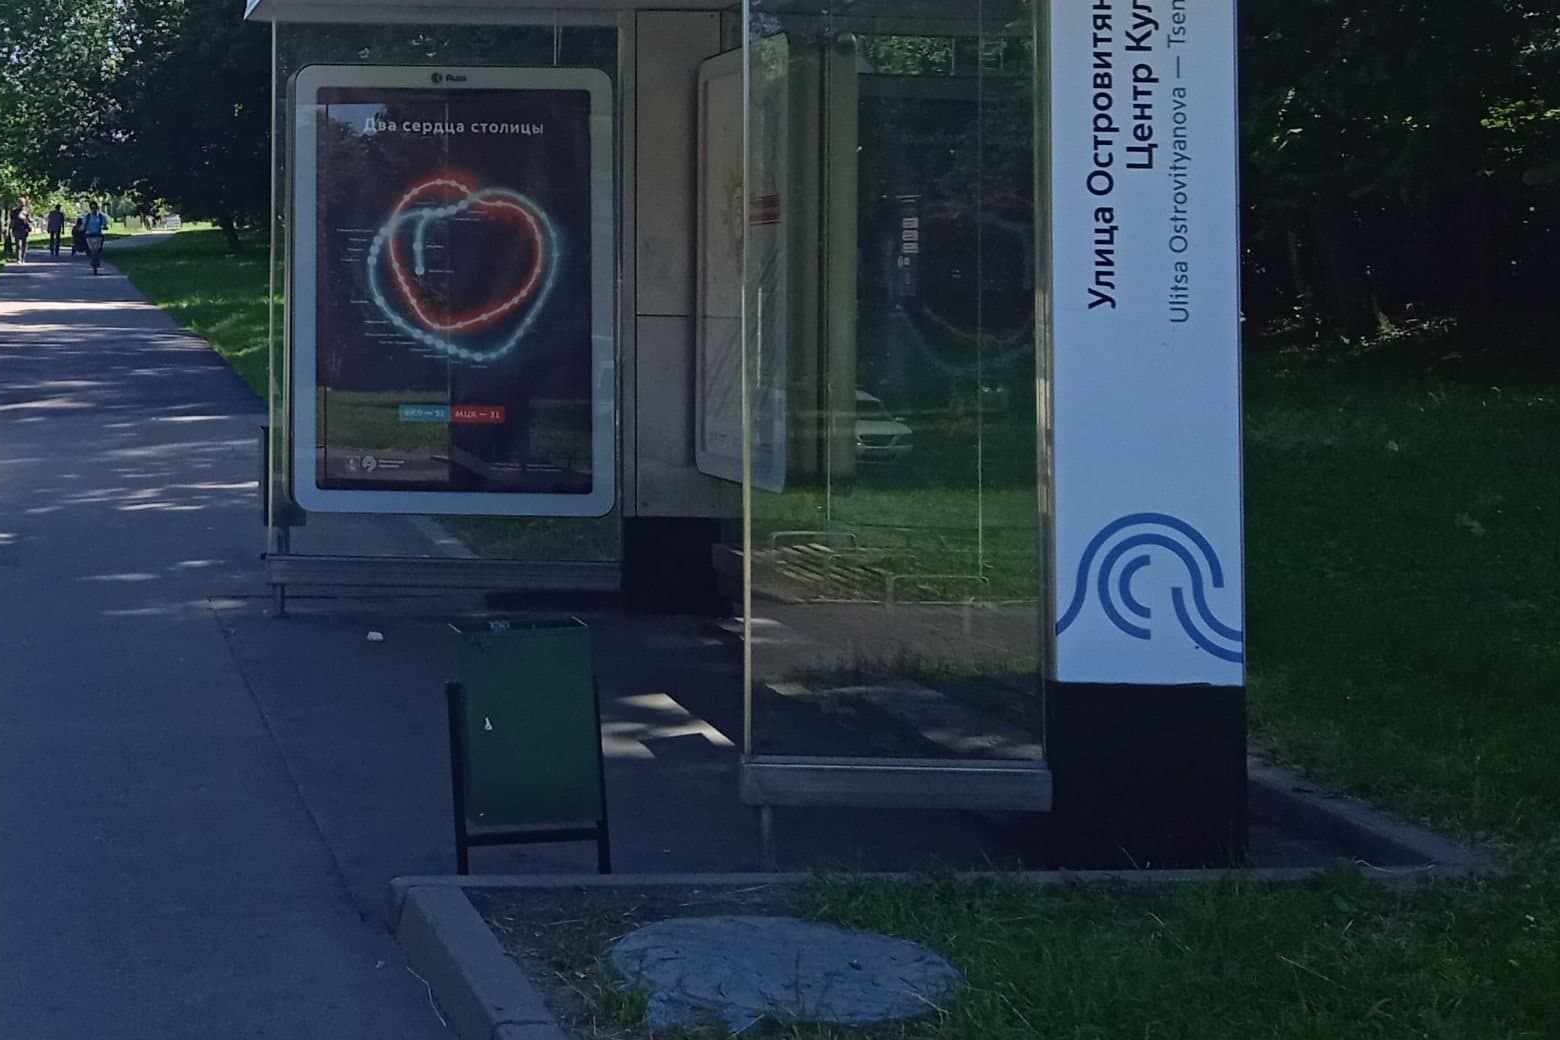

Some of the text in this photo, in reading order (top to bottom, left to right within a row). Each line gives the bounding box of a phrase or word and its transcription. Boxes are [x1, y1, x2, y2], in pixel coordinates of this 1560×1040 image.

[363, 117, 544, 135] Два сердца столицы
[1126, 63, 1159, 170] Центр
[1168, 86, 1192, 253] Ostrovityanova
[1088, 207, 1119, 309] Улица
[1169, 261, 1189, 323] Ulitsa
